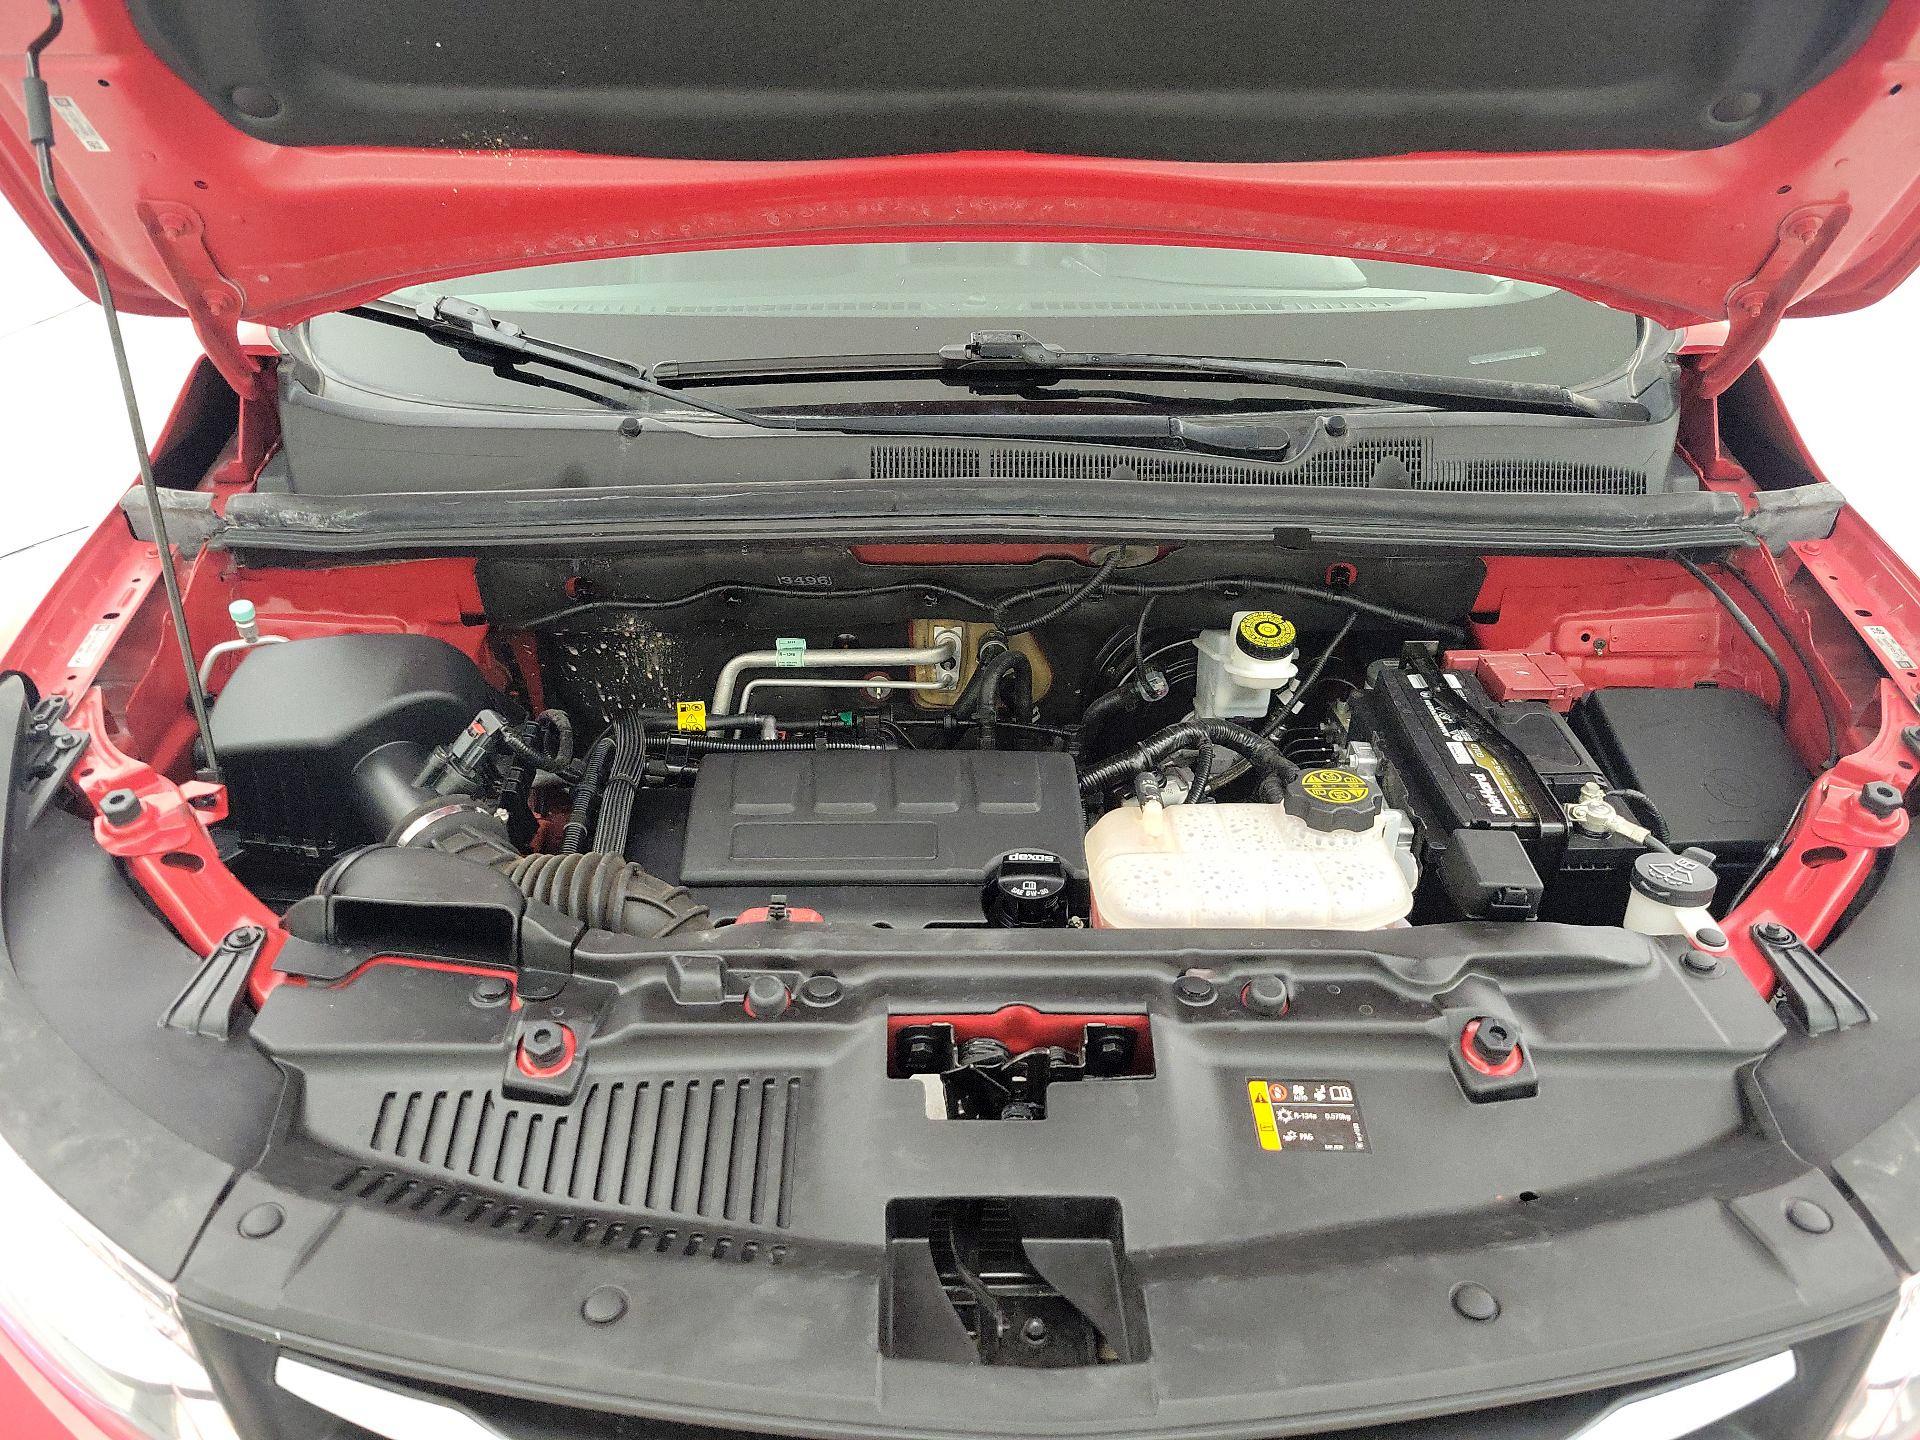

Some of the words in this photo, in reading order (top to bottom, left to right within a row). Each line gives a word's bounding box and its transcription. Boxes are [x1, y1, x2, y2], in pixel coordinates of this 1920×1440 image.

[1469, 773, 1508, 815] DieHard
[1008, 853, 1054, 862] dexos
[1010, 887, 1025, 896] SAE
[1293, 1111, 1318, 1120] R-134a
